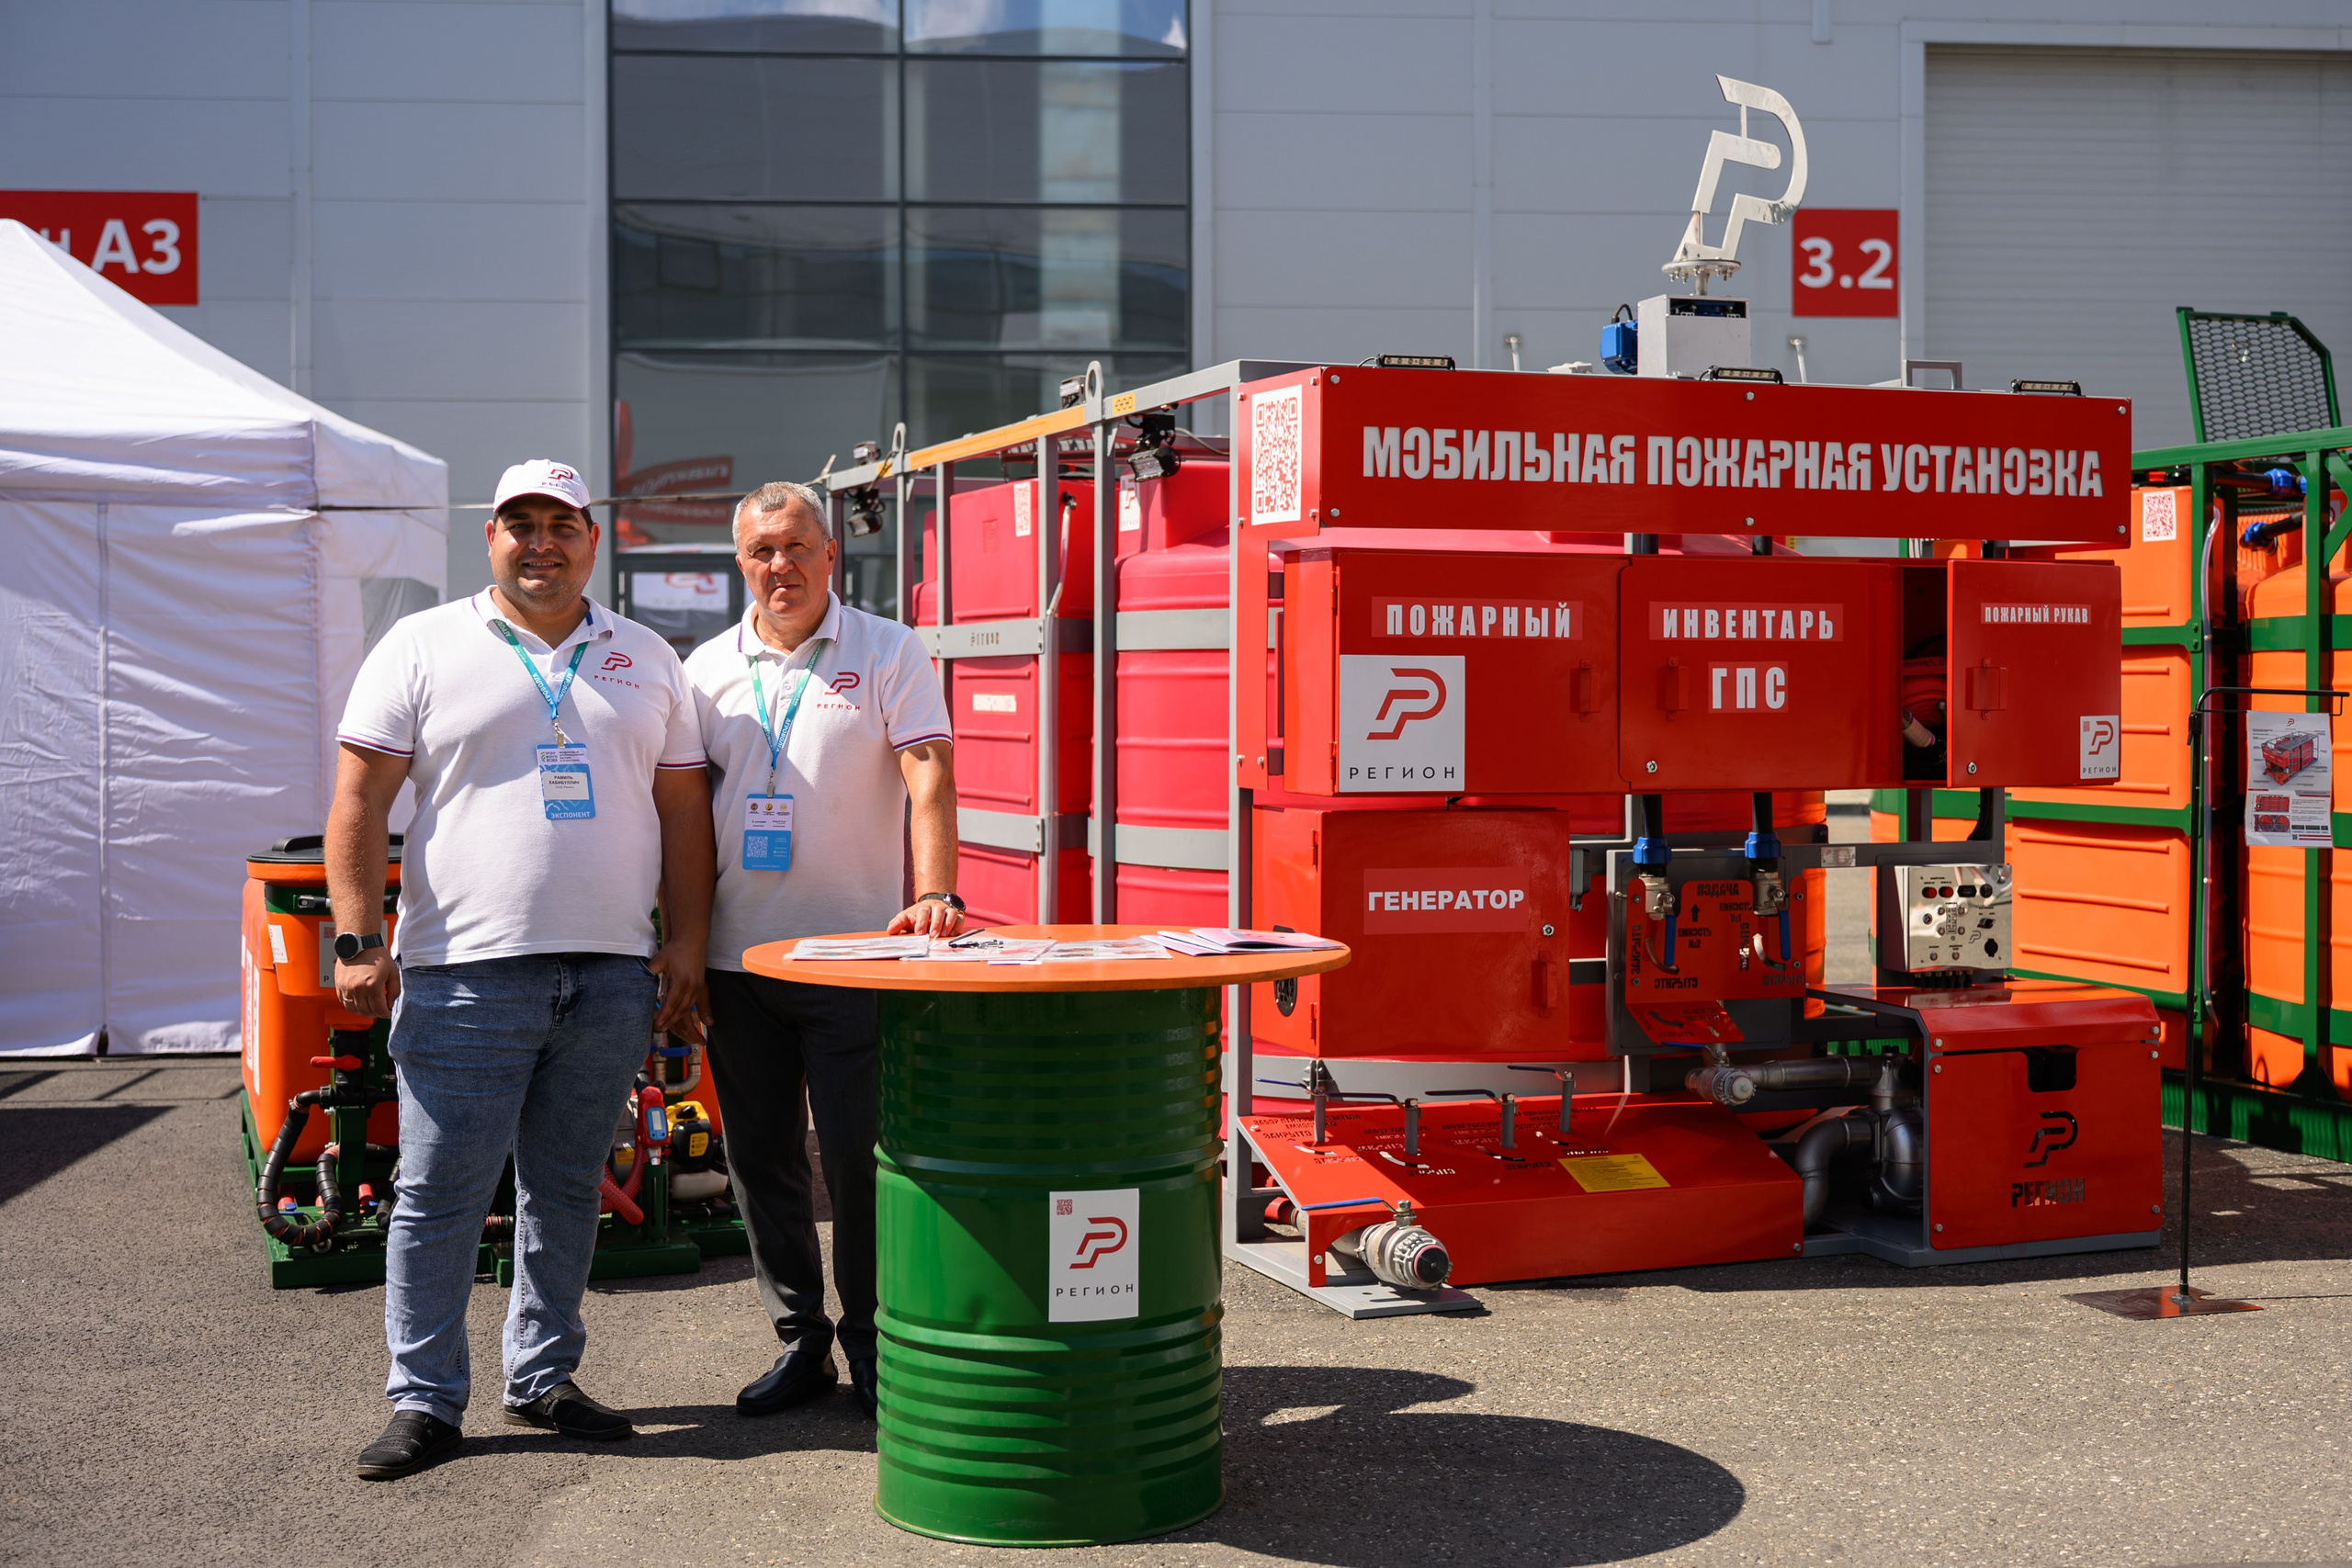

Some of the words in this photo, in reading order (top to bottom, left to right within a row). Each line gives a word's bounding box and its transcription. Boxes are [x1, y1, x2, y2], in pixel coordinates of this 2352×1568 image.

[1798, 236, 1894, 289] 3.2
[1363, 425, 1635, 485] МОБИЛЬНАЯ
[1647, 435, 1871, 491] ПОЖАРНАЯ
[1881, 443, 2104, 498] УСТАНОВКА
[1386, 602, 1570, 638] ПОЖАРНЫЙ
[1984, 604, 2050, 623] ПОЖАРНЫЙ
[2053, 607, 2088, 623] РУКАВ
[1663, 608, 1834, 639] ИНВЕНТАРЬ
[594, 675, 640, 690] РЕГИОН
[1712, 666, 1786, 709] ГПС
[817, 703, 861, 712] РЕГИОН
[1350, 766, 1455, 780] РЕГИОН
[2082, 766, 2117, 774] РЕГИОН
[550, 811, 591, 819] ЭКСПОНЕНТ
[1697, 883, 1740, 897] ПОДАЧА
[1368, 889, 1525, 911] ГЕНЕРАТОР
[1655, 976, 1699, 990] ОТКРЫТО
[2011, 1177, 2086, 1208] РЕГИОН
[1056, 1283, 1134, 1297] РЕГИОН
